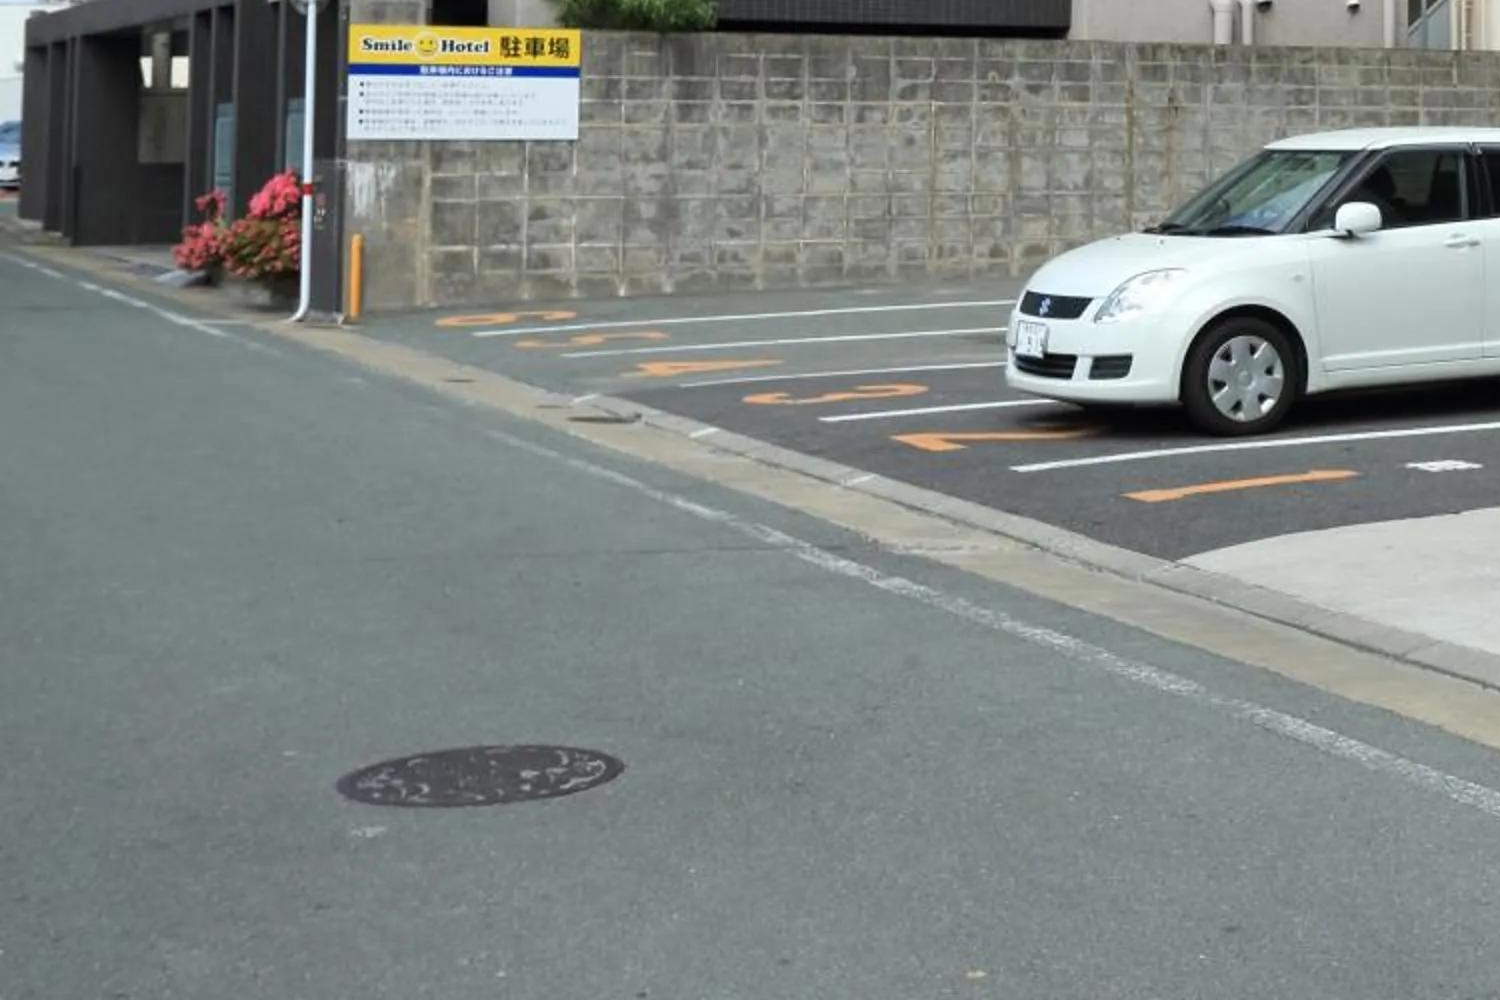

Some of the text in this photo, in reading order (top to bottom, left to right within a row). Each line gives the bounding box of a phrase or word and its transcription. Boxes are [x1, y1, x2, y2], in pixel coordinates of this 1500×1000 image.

[362, 36, 570, 59] Smile Hotel 駐車場
